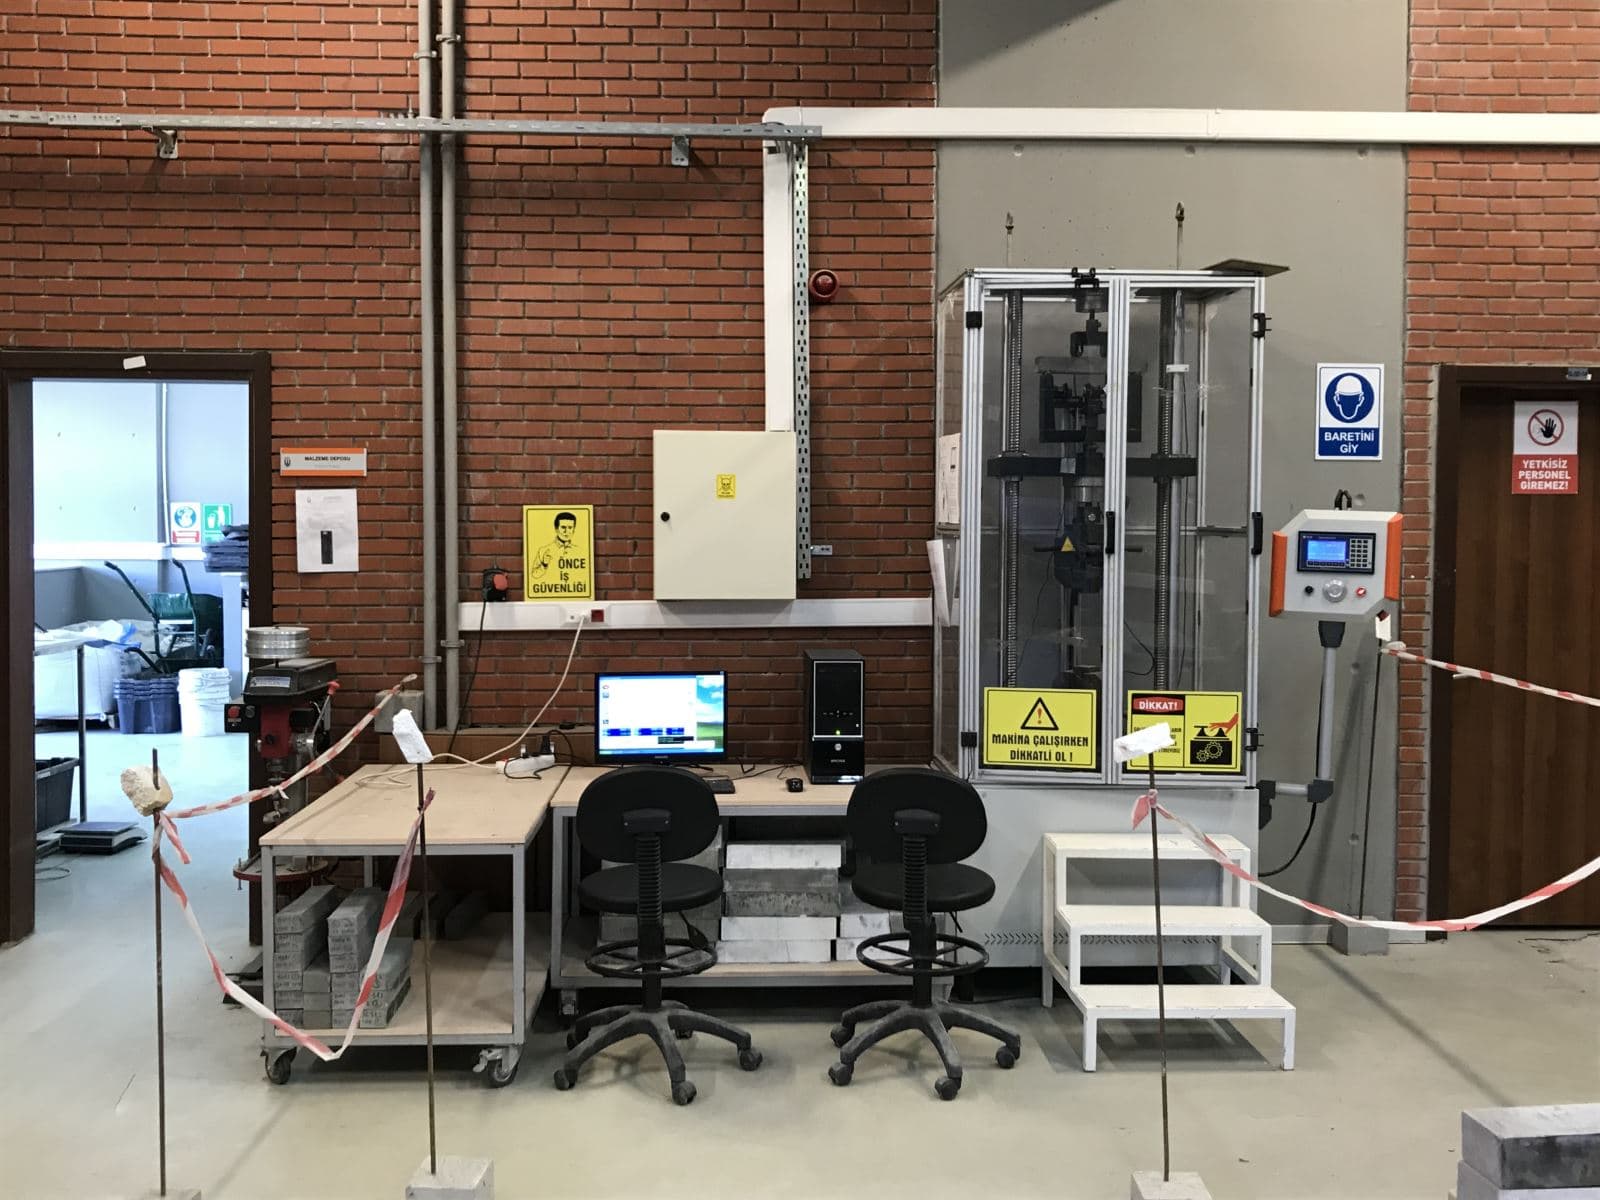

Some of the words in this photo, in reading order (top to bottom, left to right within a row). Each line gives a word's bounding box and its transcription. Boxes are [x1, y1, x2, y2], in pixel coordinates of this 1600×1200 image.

[1324, 430, 1375, 442] BARETİNİ
[1340, 442, 1359, 454] GİY
[1522, 458, 1568, 469] YETKİSİZ
[1518, 470, 1571, 480] PERSONEL
[1520, 479, 1569, 490] GİREMEZ!
[558, 556, 586, 569] ÖNCE
[560, 571, 569, 583] İŞ
[533, 581, 587, 593] GÜVENLİĞİ
[1139, 699, 1178, 711] DİKKAT!
[992, 732, 1030, 745] MAKİNA
[1033, 735, 1089, 748] ÇALIŞIRKEN
[1010, 748, 1052, 761] DİKKATLİ
[1055, 751, 1067, 762] OL
